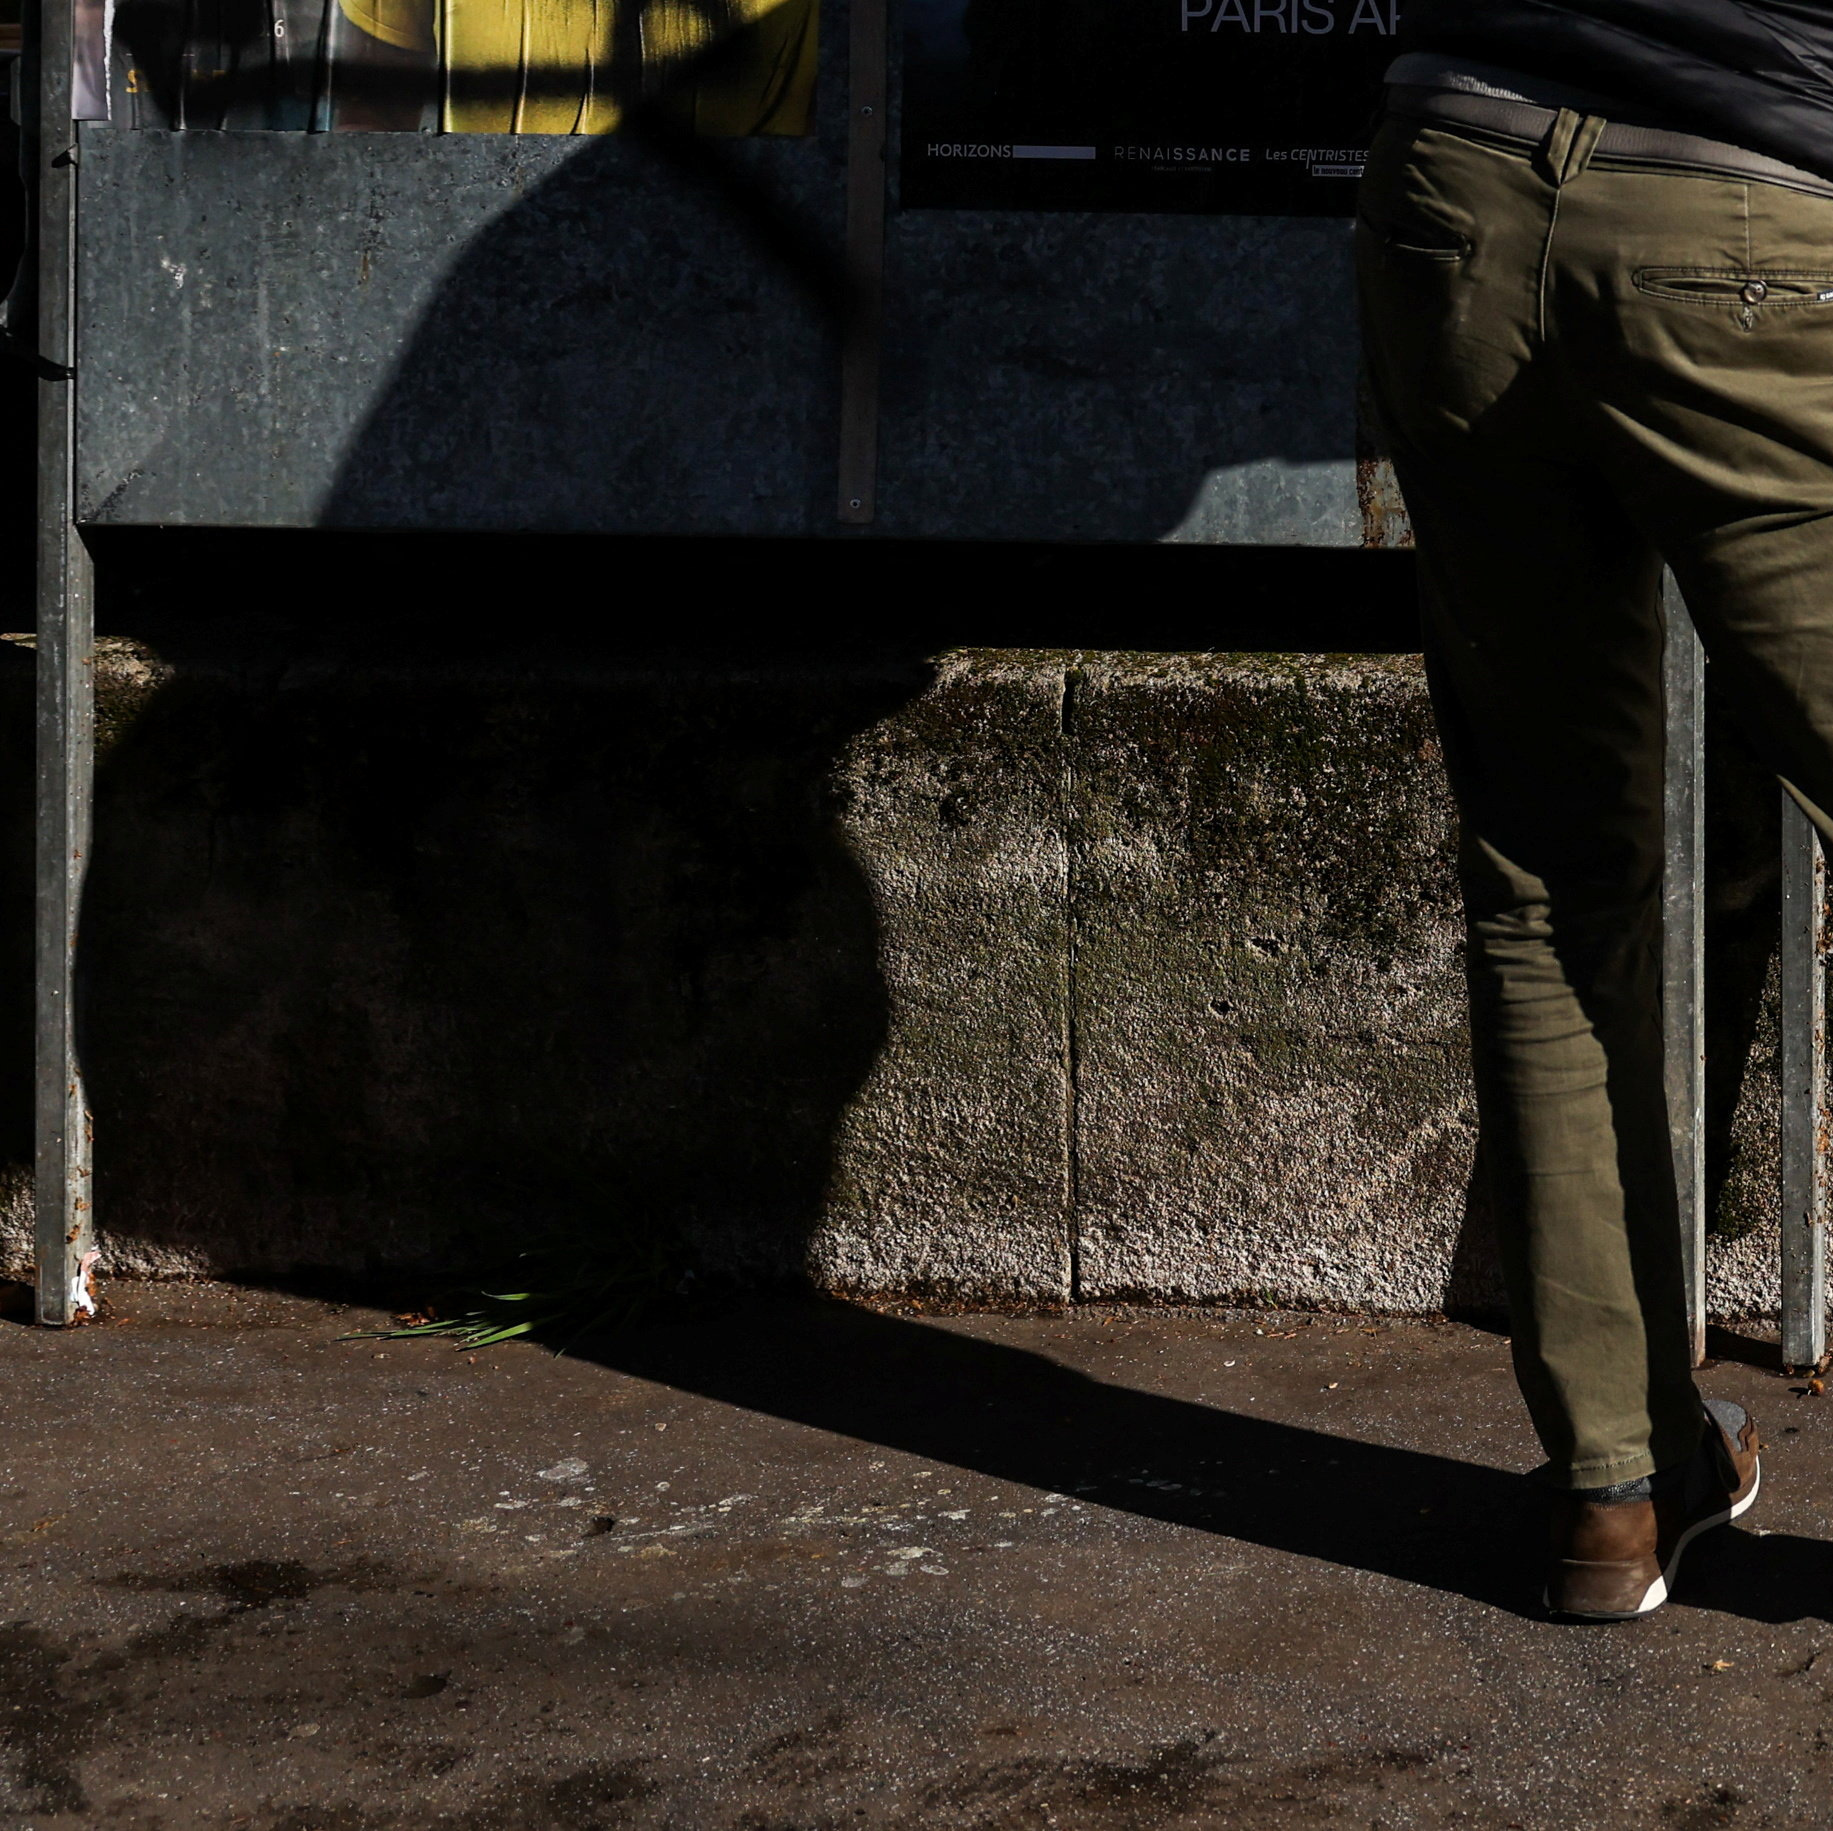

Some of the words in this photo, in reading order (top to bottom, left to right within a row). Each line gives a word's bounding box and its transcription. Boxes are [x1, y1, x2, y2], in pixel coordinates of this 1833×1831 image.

[927, 143, 1012, 159] HORIZONS
[1114, 146, 1251, 163] RENAISSANCE
[1265, 148, 1288, 162] Les
